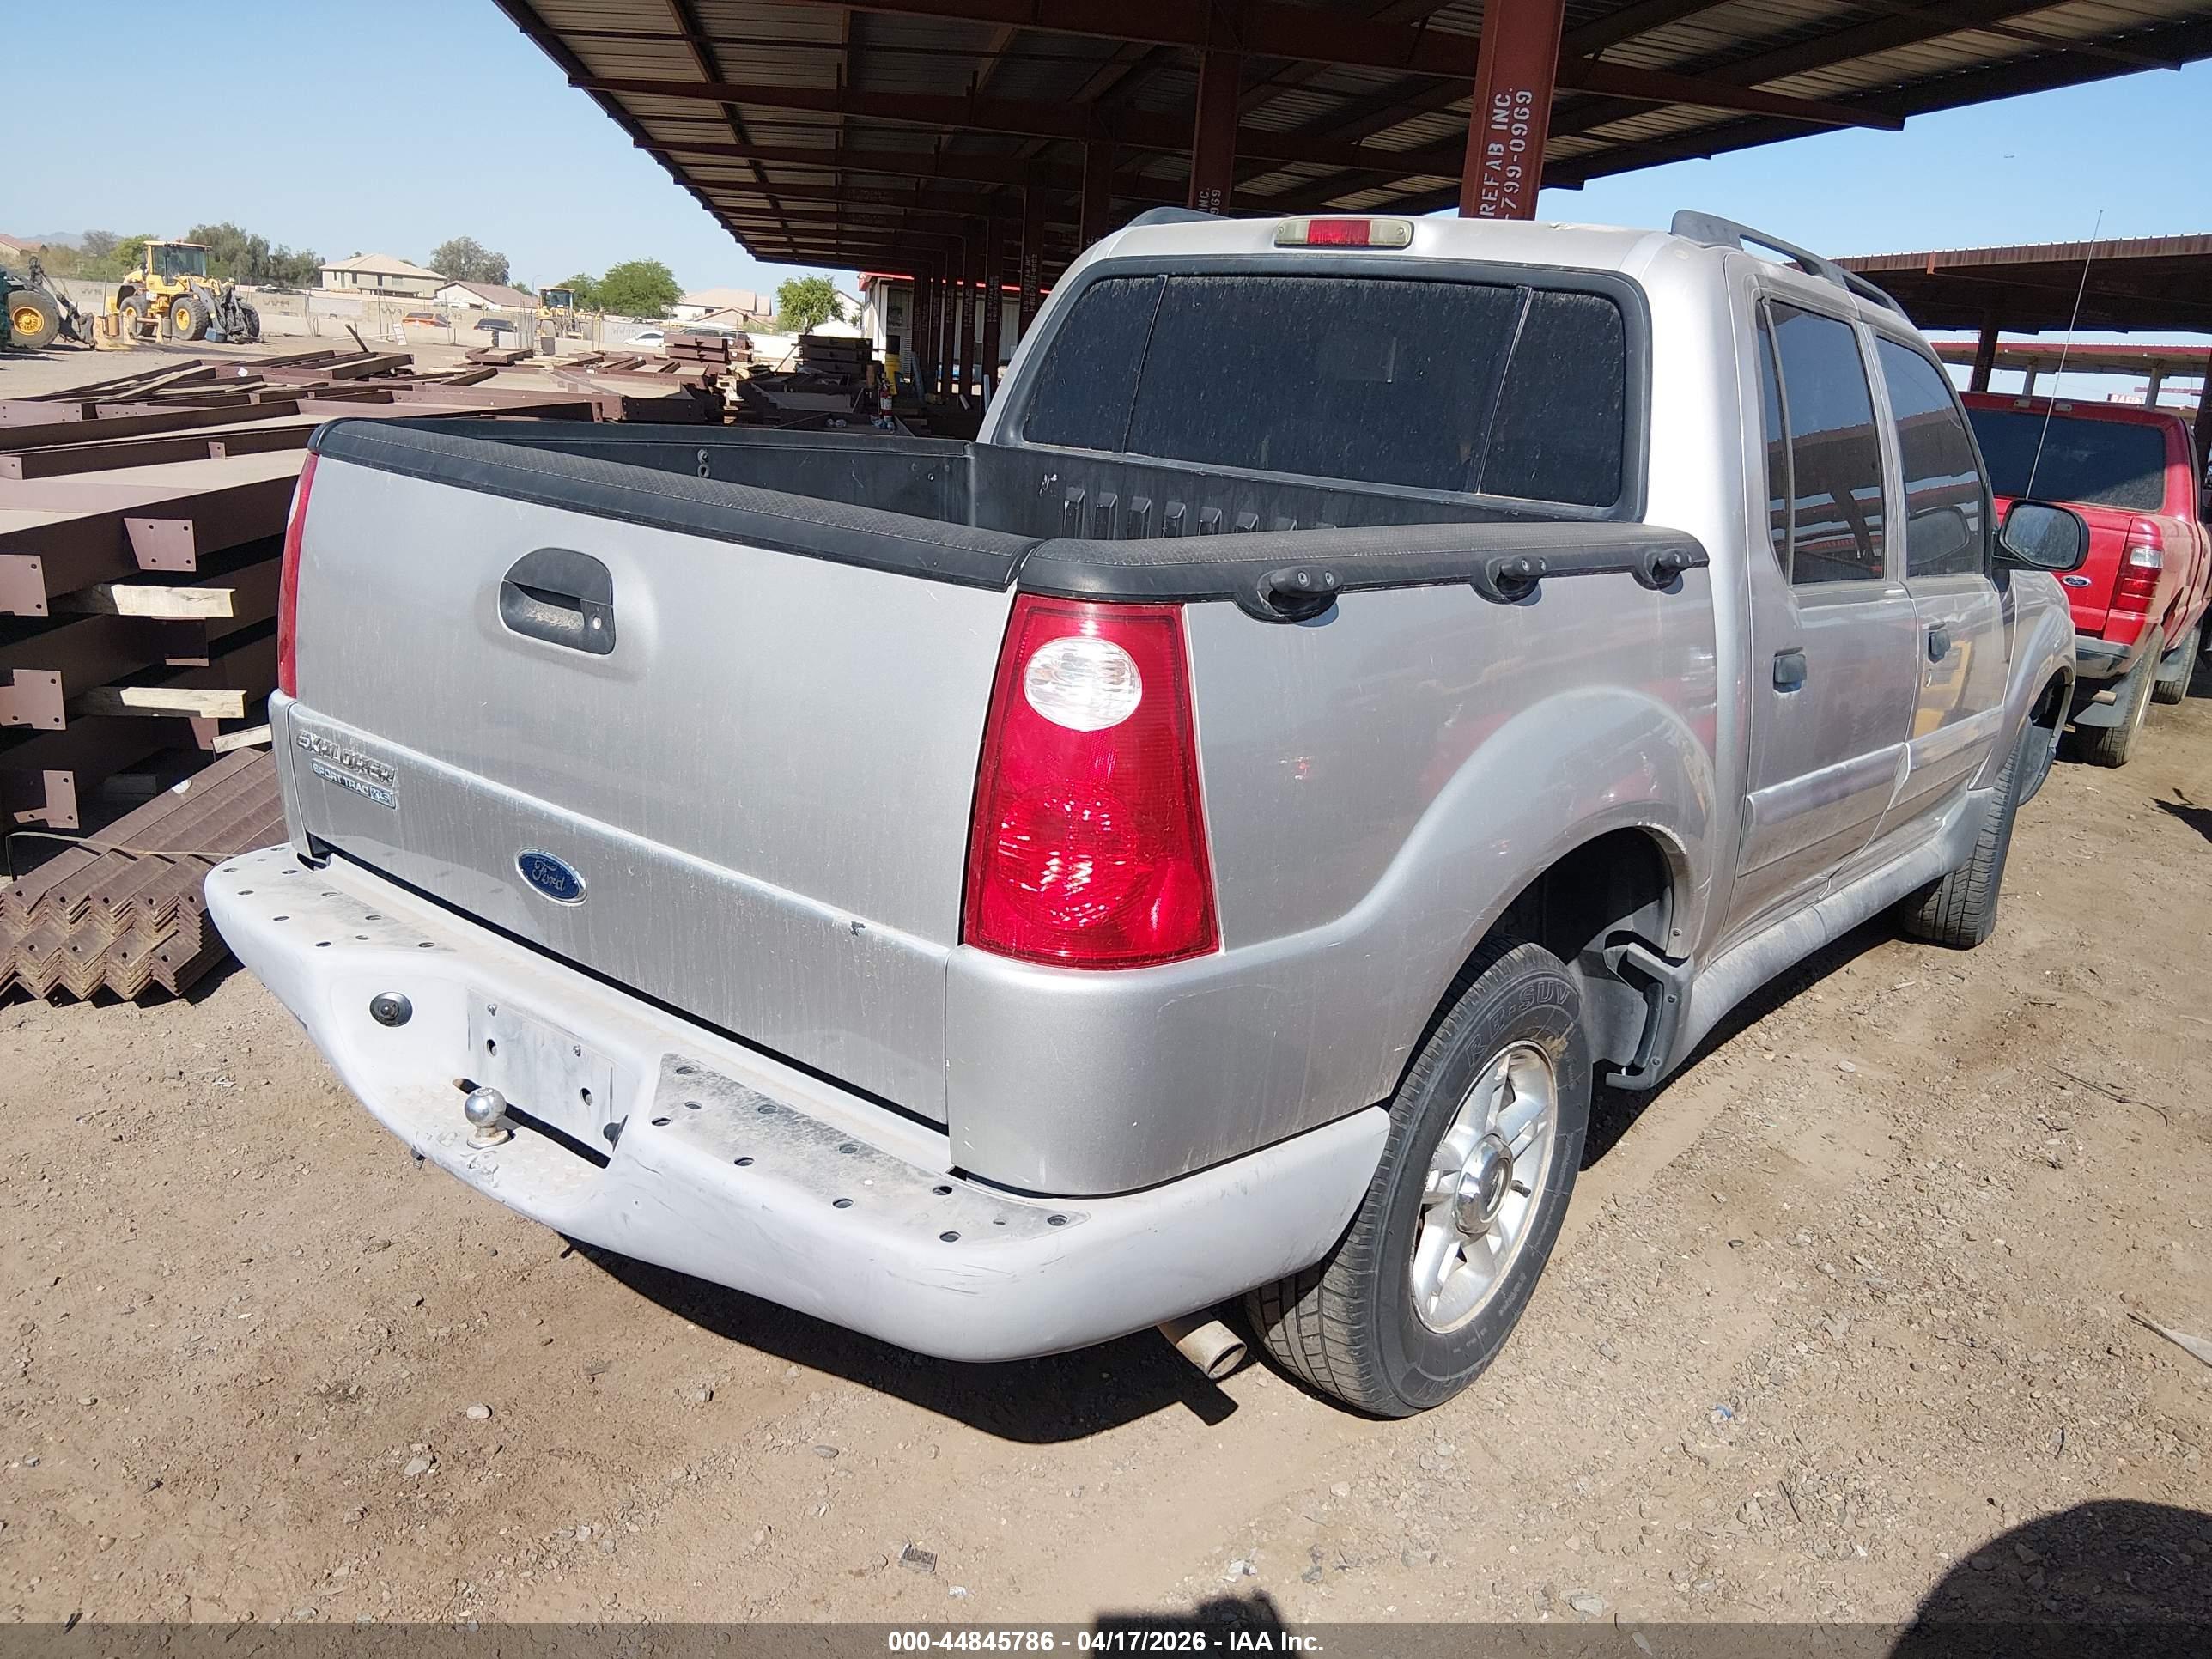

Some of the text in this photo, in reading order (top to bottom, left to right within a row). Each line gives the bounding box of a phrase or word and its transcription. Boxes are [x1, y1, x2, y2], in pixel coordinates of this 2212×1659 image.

[1491, 87, 1513, 131] INC.
[313, 763, 343, 785] SPORT
[344, 777, 369, 795] TRAC
[532, 860, 565, 892] Ford
